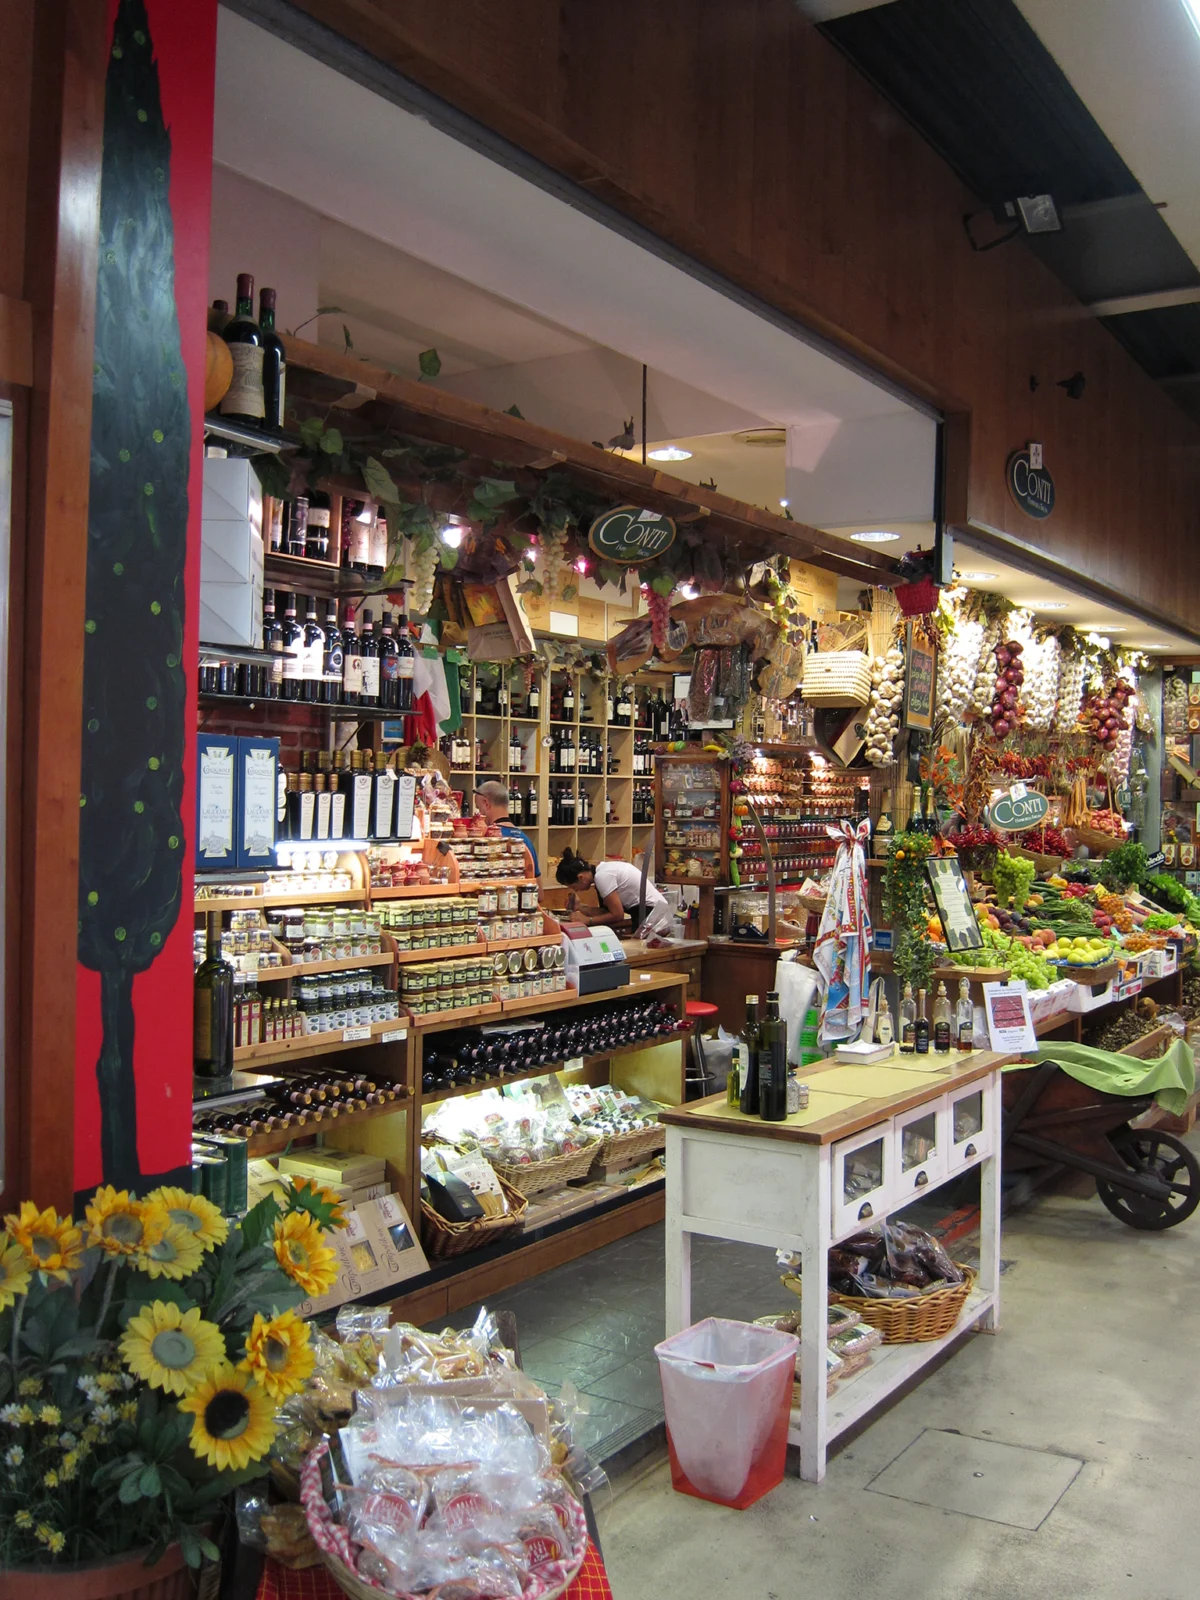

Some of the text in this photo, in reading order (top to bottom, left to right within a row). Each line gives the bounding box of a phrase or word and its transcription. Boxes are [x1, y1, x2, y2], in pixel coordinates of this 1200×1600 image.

[1014, 459, 1051, 504] CONTI
[600, 514, 668, 550] CONTI
[995, 796, 1042, 823] CONTI
